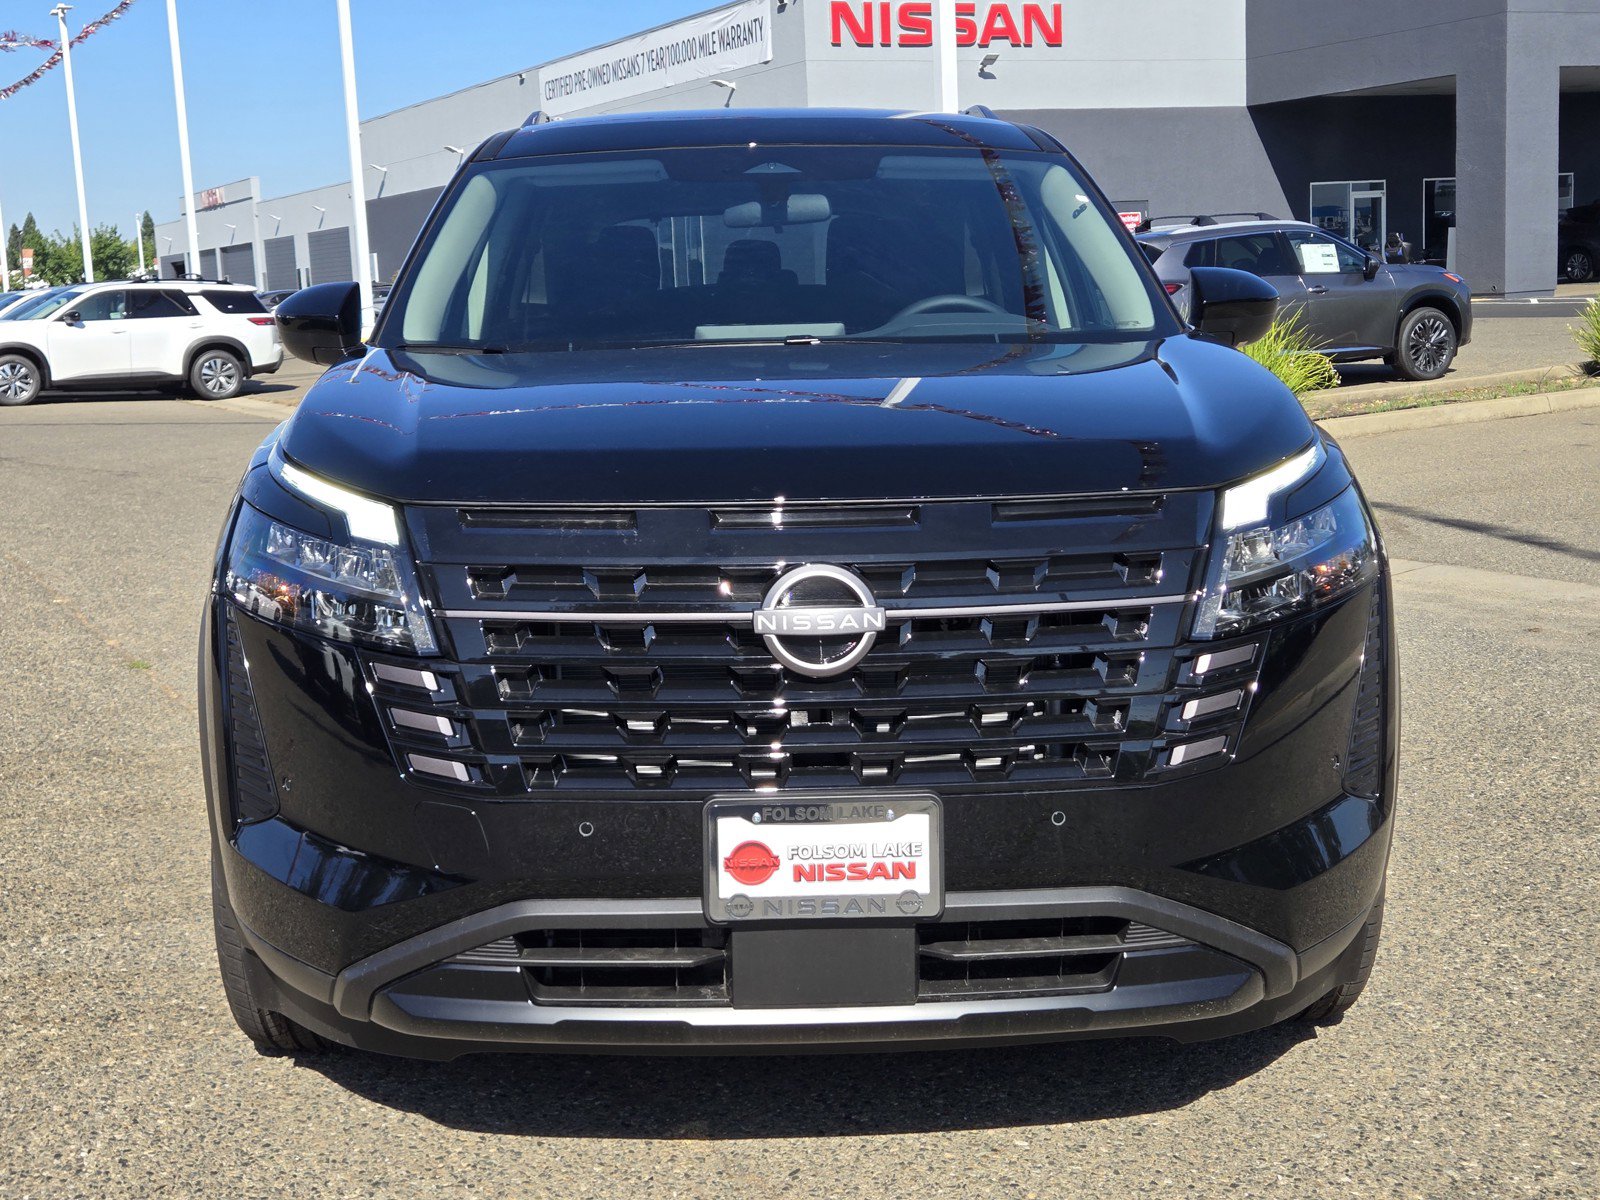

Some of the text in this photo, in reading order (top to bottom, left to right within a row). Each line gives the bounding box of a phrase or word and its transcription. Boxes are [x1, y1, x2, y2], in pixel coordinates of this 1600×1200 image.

[831, 1, 1062, 47] NISSAN
[544, 74, 574, 101] CERTIFIED
[574, 62, 611, 93] PRE-OWNED
[611, 54, 640, 82] NISSANS
[640, 52, 645, 75] 7
[698, 31, 717, 59] MILE
[717, 16, 764, 53] WARRANTY
[757, 612, 882, 630] NISSAN
[762, 805, 884, 821] FOLSOM LAKE
[787, 841, 923, 861] FOLSOM LAKE
[723, 856, 781, 869] NISSAN
[793, 861, 917, 883] NISSAN
[762, 898, 887, 916] NISSAN
